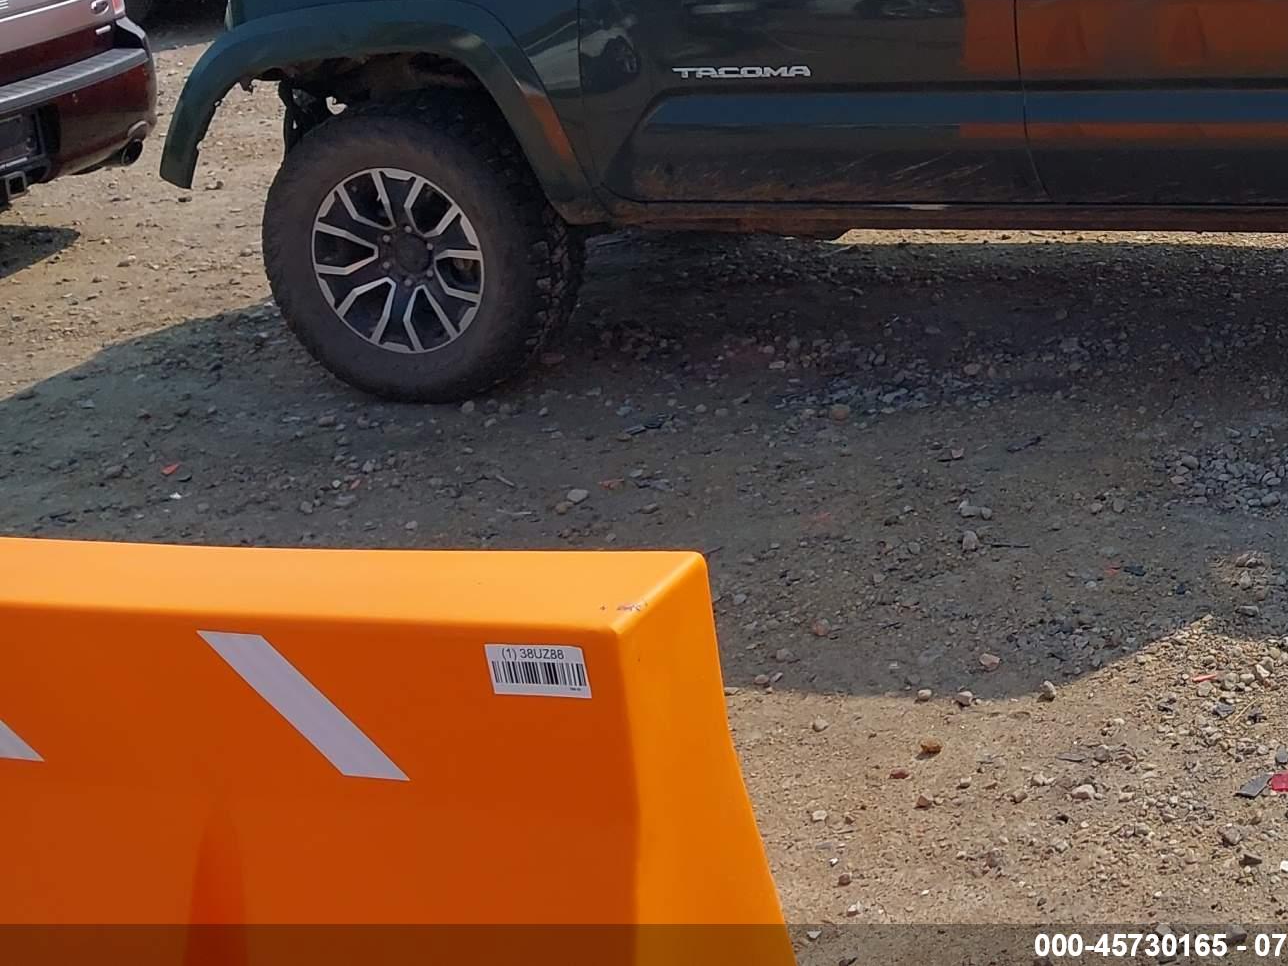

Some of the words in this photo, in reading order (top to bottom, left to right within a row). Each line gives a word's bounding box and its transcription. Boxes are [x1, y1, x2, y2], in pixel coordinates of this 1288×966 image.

[672, 65, 812, 79] TACOMA
[501, 648, 517, 661] (1)
[519, 648, 565, 660] 38UZ88
